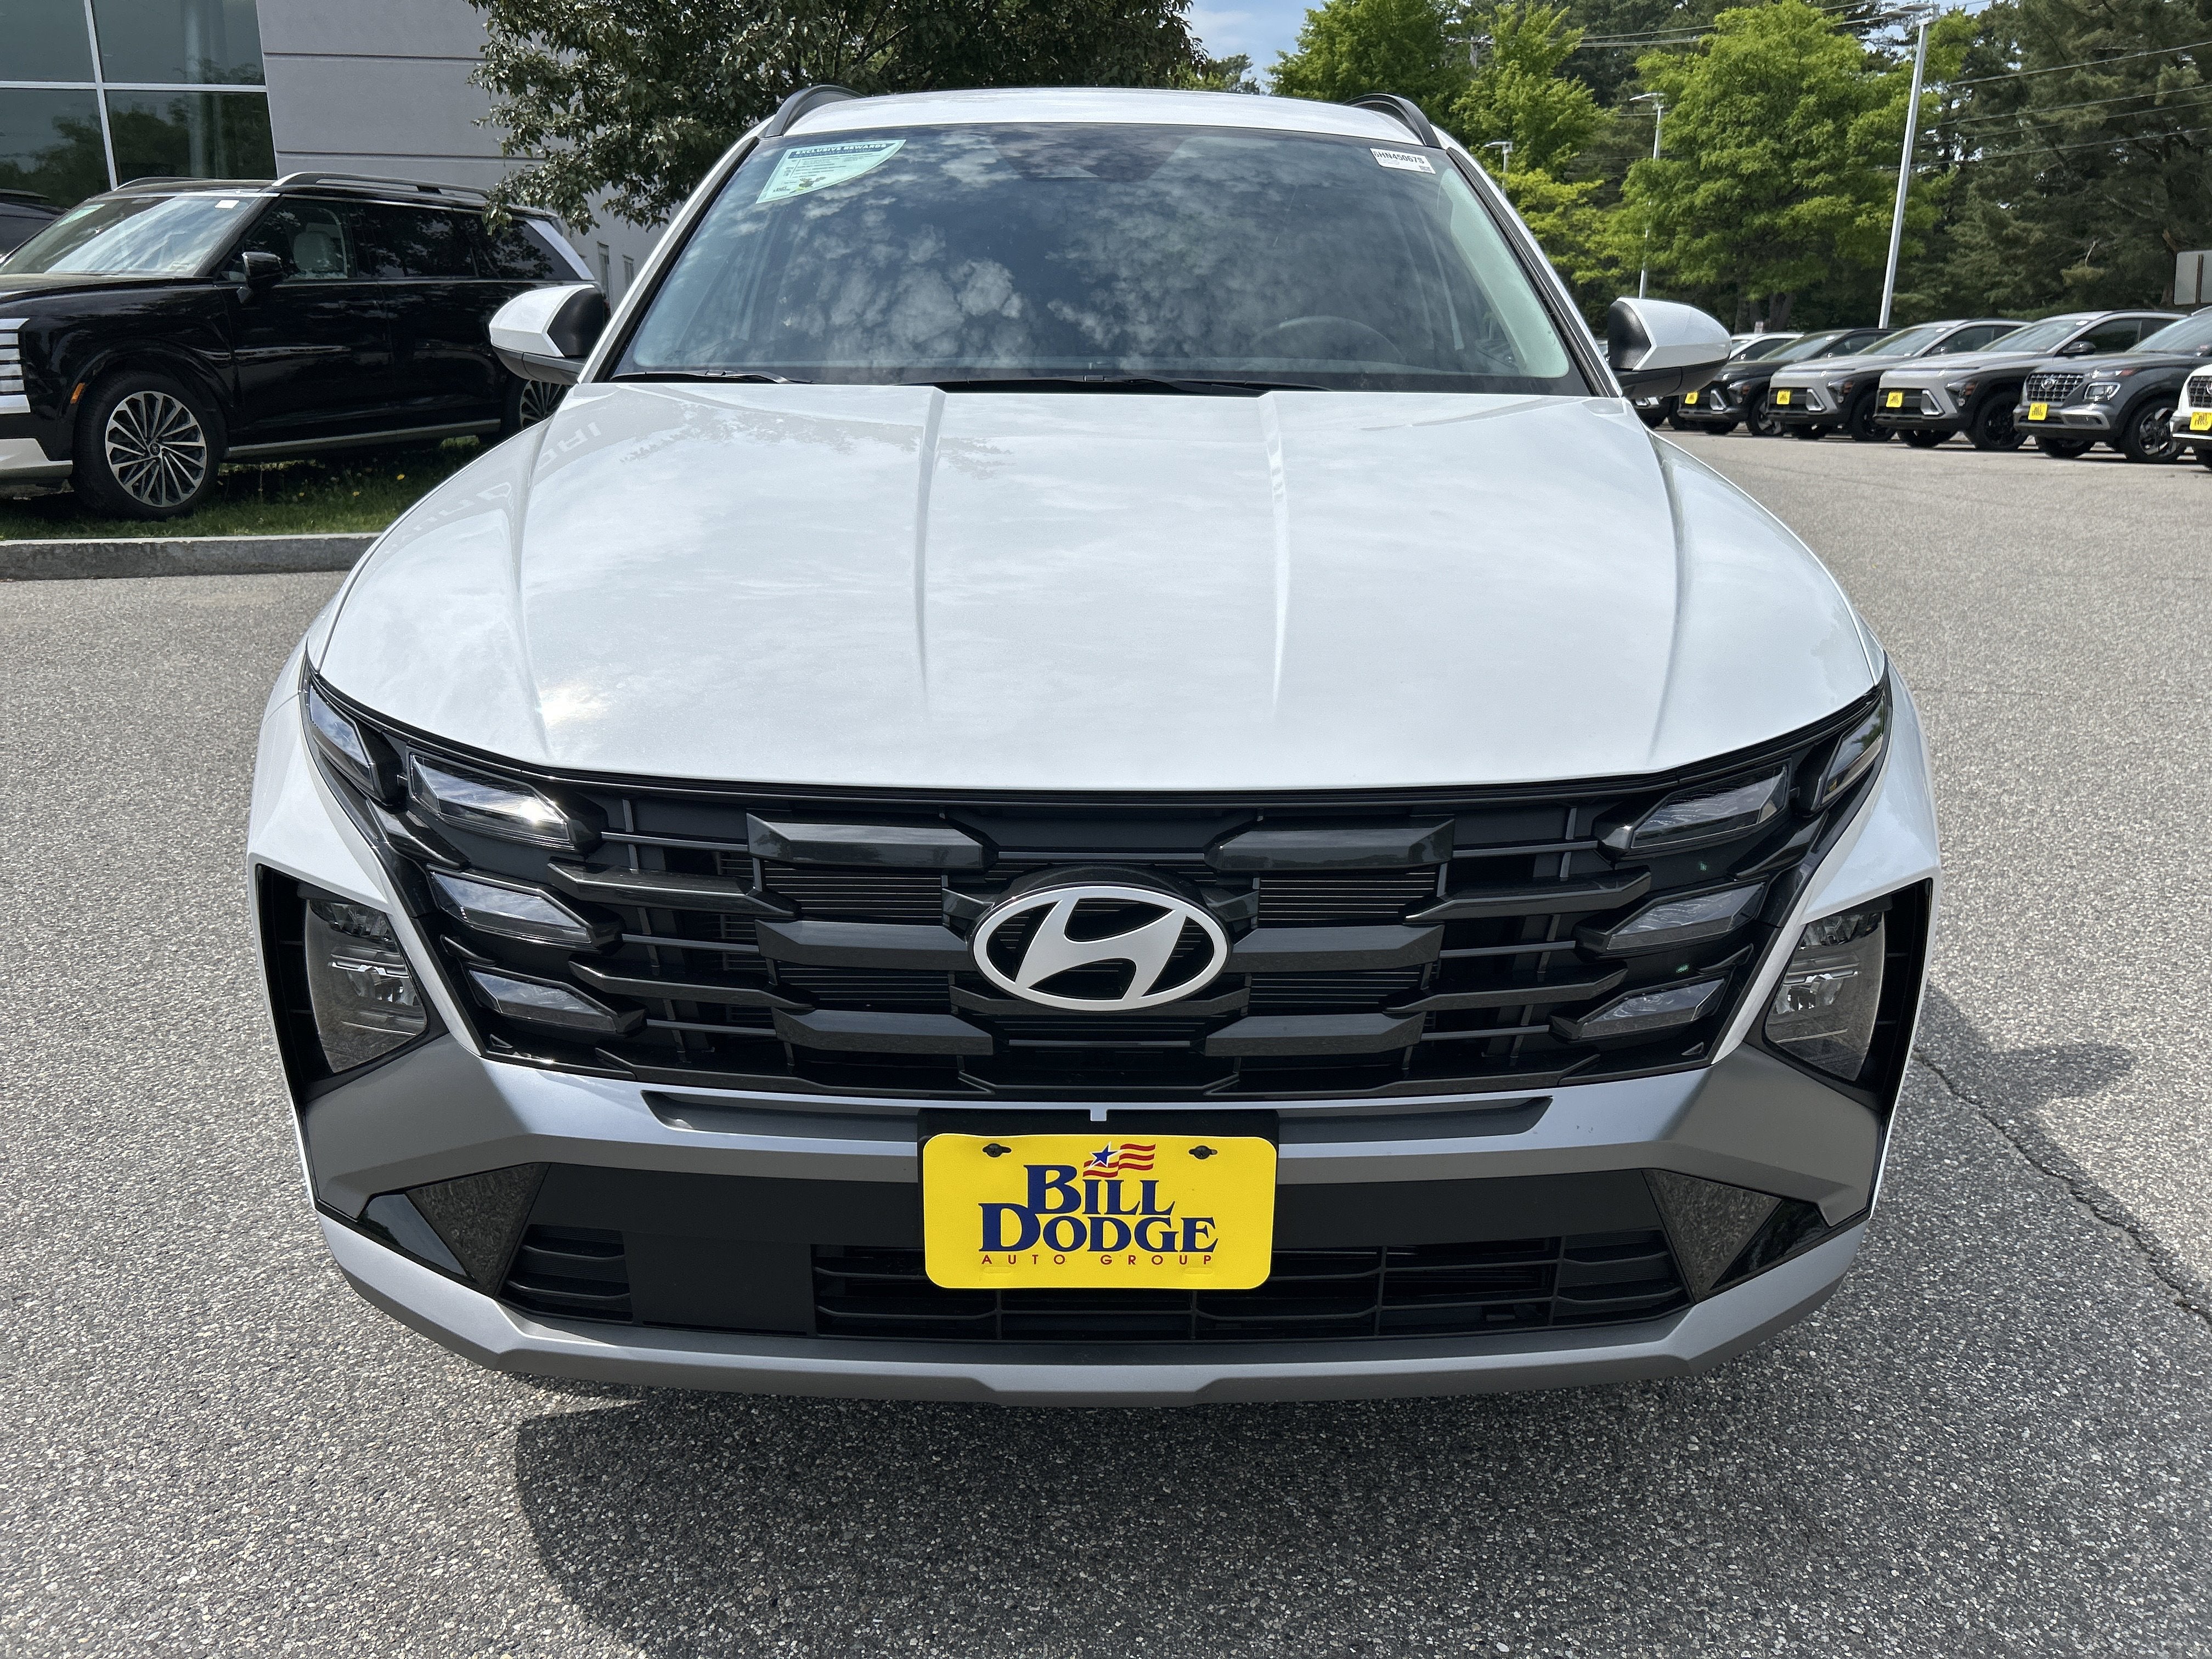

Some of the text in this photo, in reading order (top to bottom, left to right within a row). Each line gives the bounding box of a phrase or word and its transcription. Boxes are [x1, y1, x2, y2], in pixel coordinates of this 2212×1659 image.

[1023, 1164, 1175, 1215] BILL
[978, 1203, 1218, 1252] DODGE
[981, 1254, 1212, 1265] AUTO GROUP
